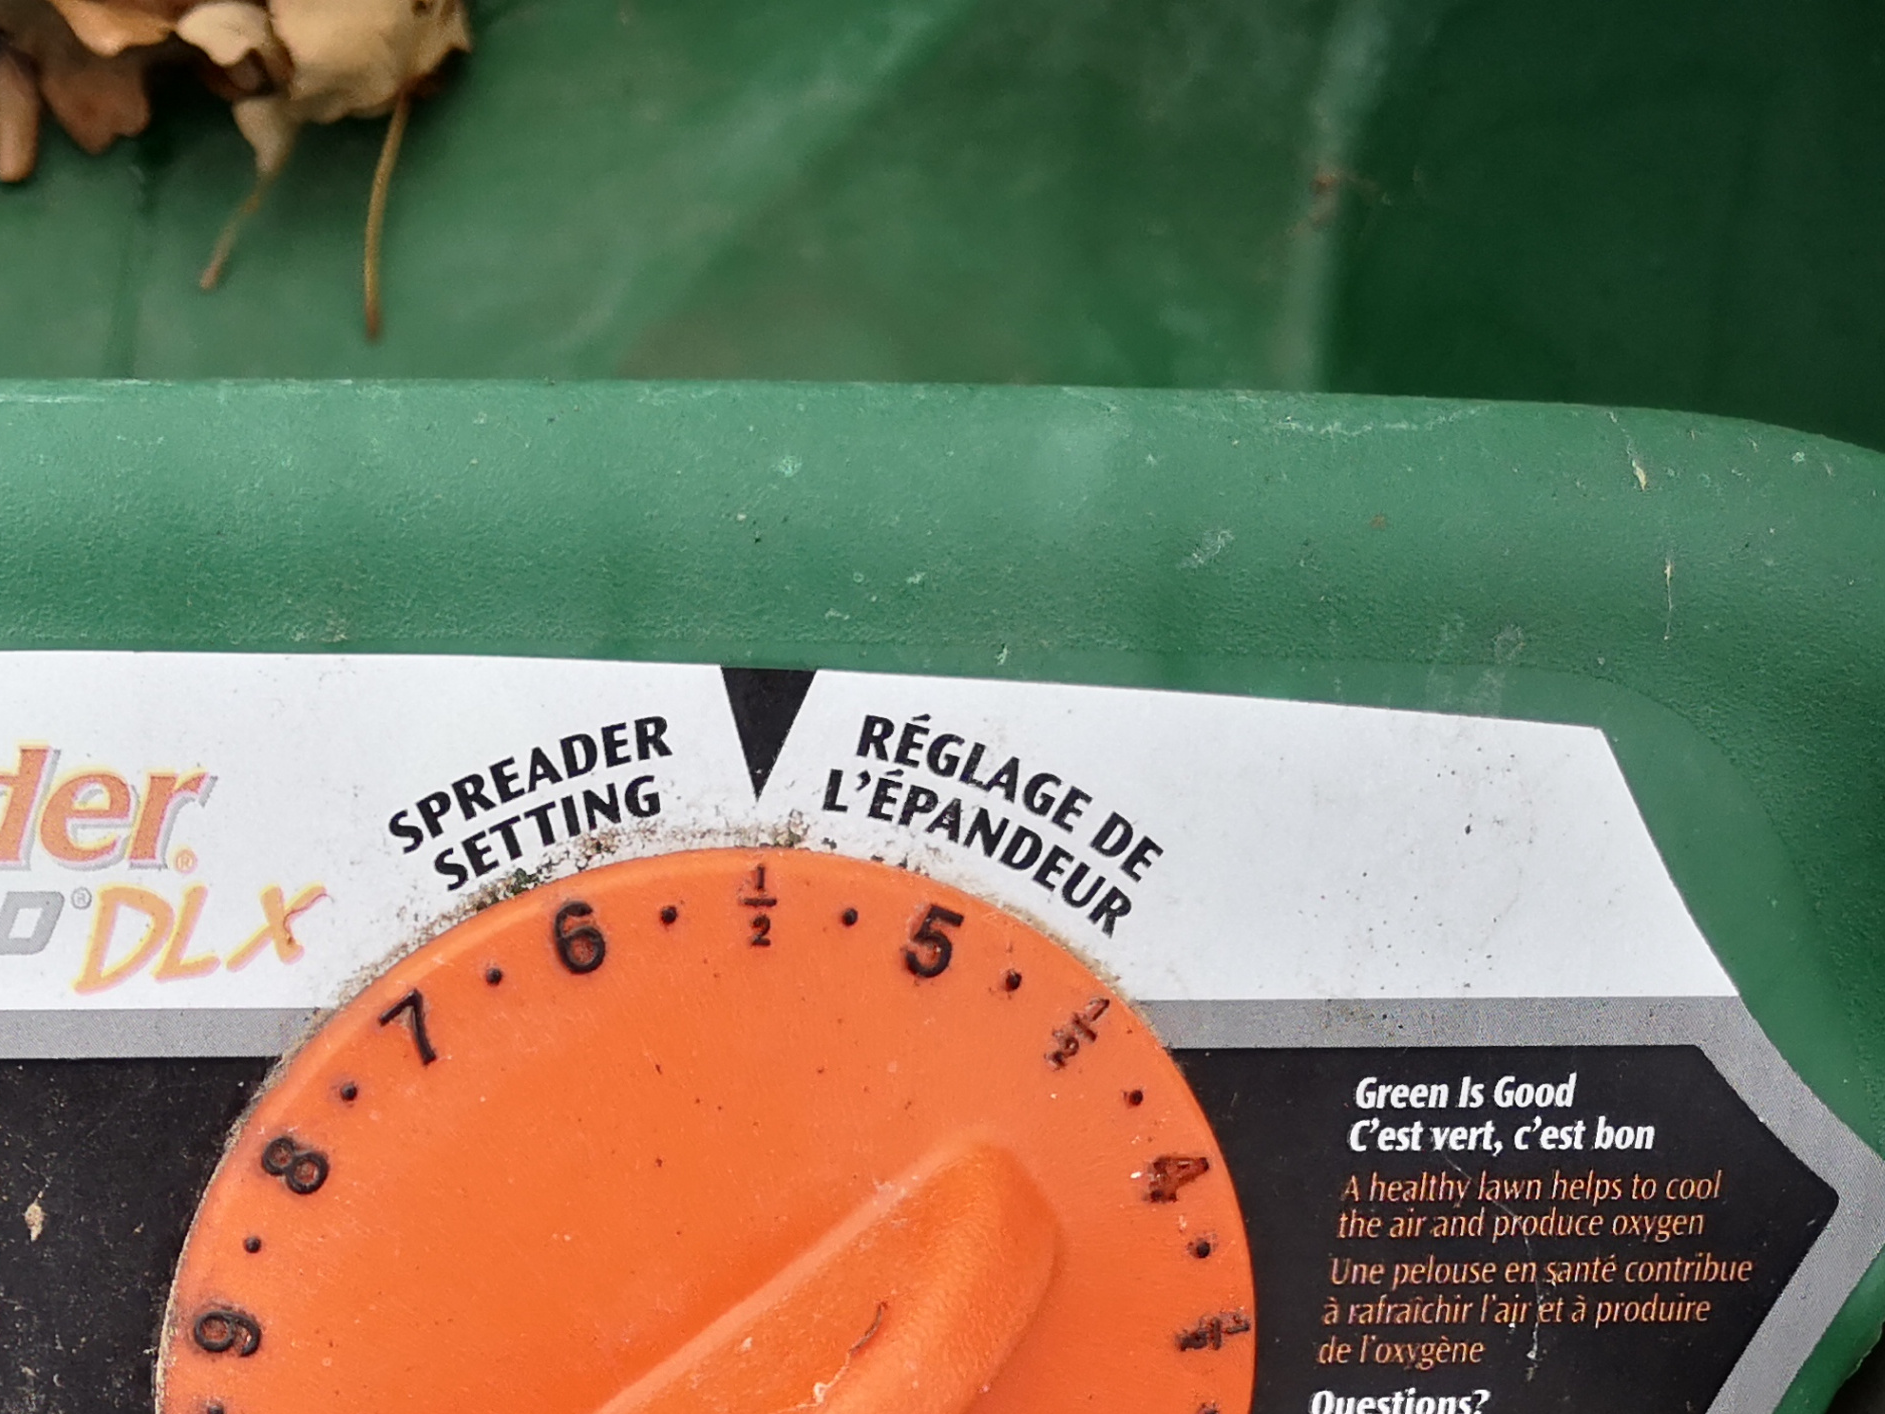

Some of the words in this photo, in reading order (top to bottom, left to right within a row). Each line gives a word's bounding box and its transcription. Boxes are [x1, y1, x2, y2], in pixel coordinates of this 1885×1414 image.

[387, 715, 673, 855] SPREADER
[857, 712, 1093, 833] RÉGLAGE
[1090, 804, 1164, 883] DE
[433, 774, 662, 892] SETTING
[72, 884, 330, 997] DLX
[553, 900, 606, 974] 6
[904, 904, 964, 978] 5
[378, 991, 438, 1067] 7
[1355, 1077, 1449, 1109] Green
[1458, 1077, 1485, 1109] Is
[1494, 1073, 1577, 1108] Good
[1431, 1121, 1504, 1155] vert,
[1594, 1116, 1655, 1150] bon
[259, 1136, 330, 1197] 8
[1144, 1153, 1211, 1202] 4
[1342, 1174, 1360, 1201] A
[1369, 1171, 1472, 1208] healthy
[1477, 1171, 1543, 1200] lawn
[1552, 1169, 1623, 1206] helps
[1632, 1174, 1657, 1199] to
[1665, 1170, 1723, 1199] cool
[1337, 1211, 1381, 1239] the
[1389, 1209, 1429, 1237] air
[1433, 1208, 1486, 1237] and
[1493, 1207, 1603, 1244] produce
[1612, 1213, 1705, 1243] oxygen
[1329, 1257, 1384, 1285] Une
[1392, 1256, 1495, 1291] pelouse
[1504, 1261, 1536, 1284] en
[1545, 1254, 1617, 1284] santé
[1624, 1253, 1754, 1282] contribue
[191, 1307, 263, 1359] 9
[1347, 1296, 1473, 1325] rafraîchir
[1594, 1293, 1711, 1329] produire
[1318, 1337, 1352, 1365] de
